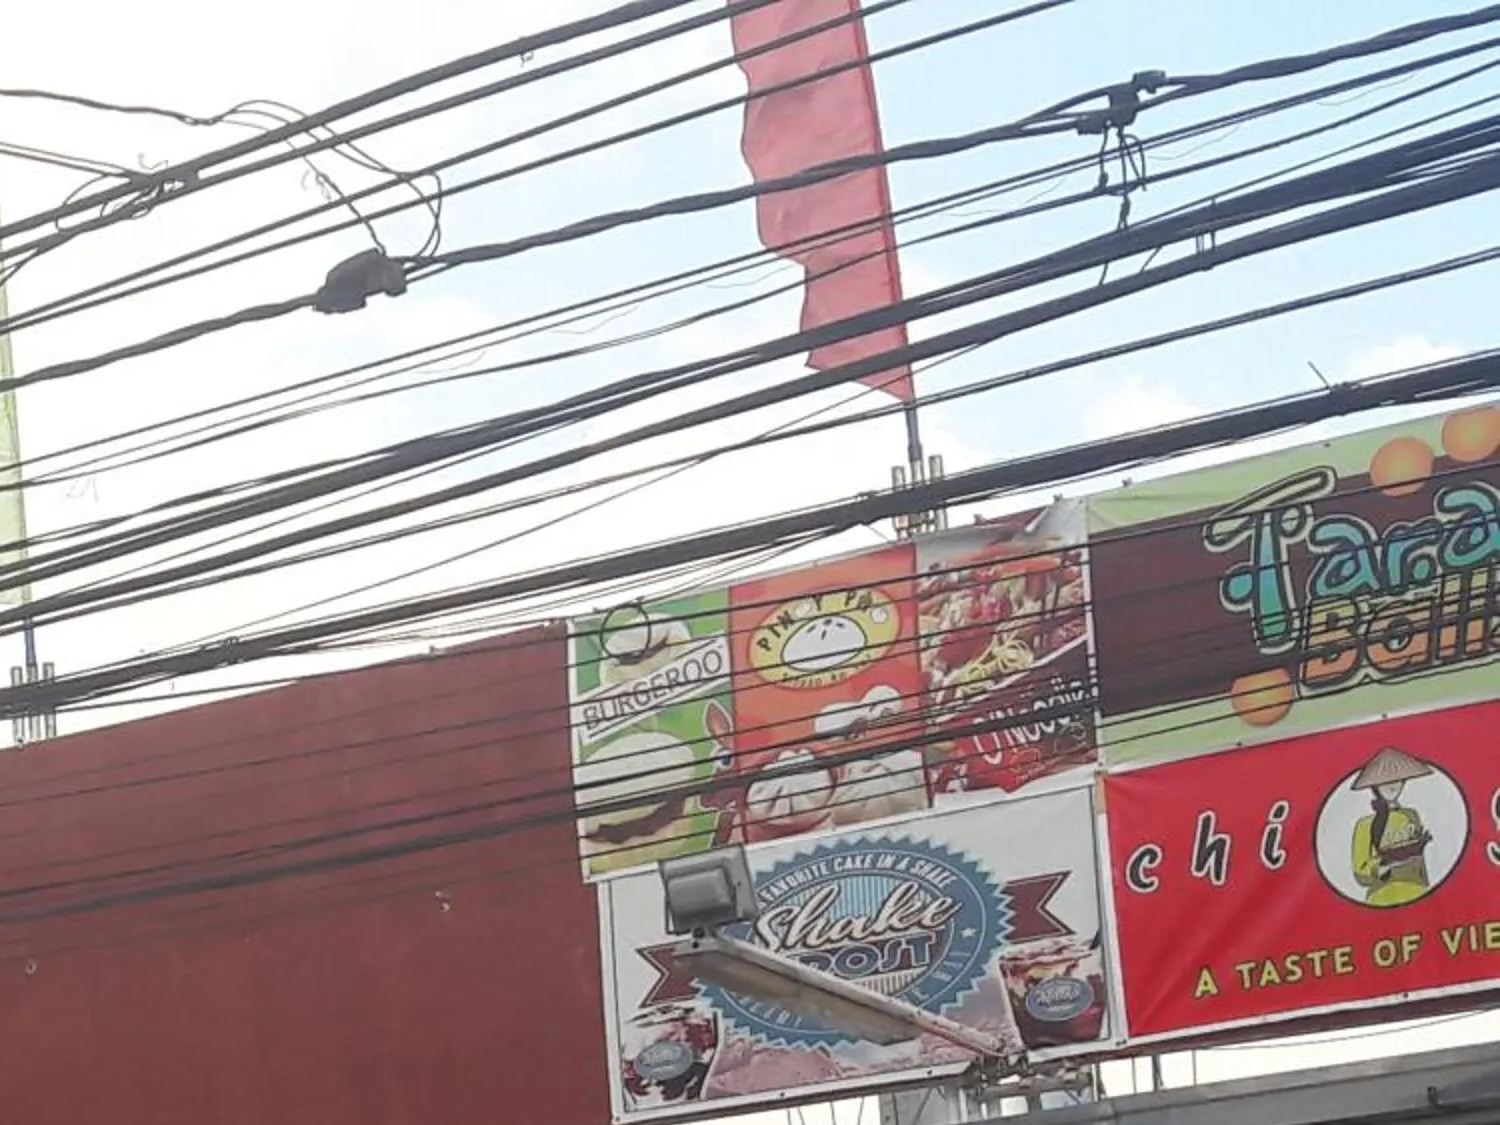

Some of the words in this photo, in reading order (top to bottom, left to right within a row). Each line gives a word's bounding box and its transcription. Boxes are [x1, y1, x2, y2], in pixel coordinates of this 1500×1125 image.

[1301, 562, 1500, 692] Ball
[583, 649, 722, 731] BURGEROO
[833, 853, 873, 872] CAKE
[876, 853, 896, 869] IN
[909, 859, 957, 888] SHAKE
[754, 881, 963, 951] Shake
[1194, 967, 1219, 998] A
[1235, 946, 1354, 990] TASTE
[1373, 933, 1422, 967] OF
